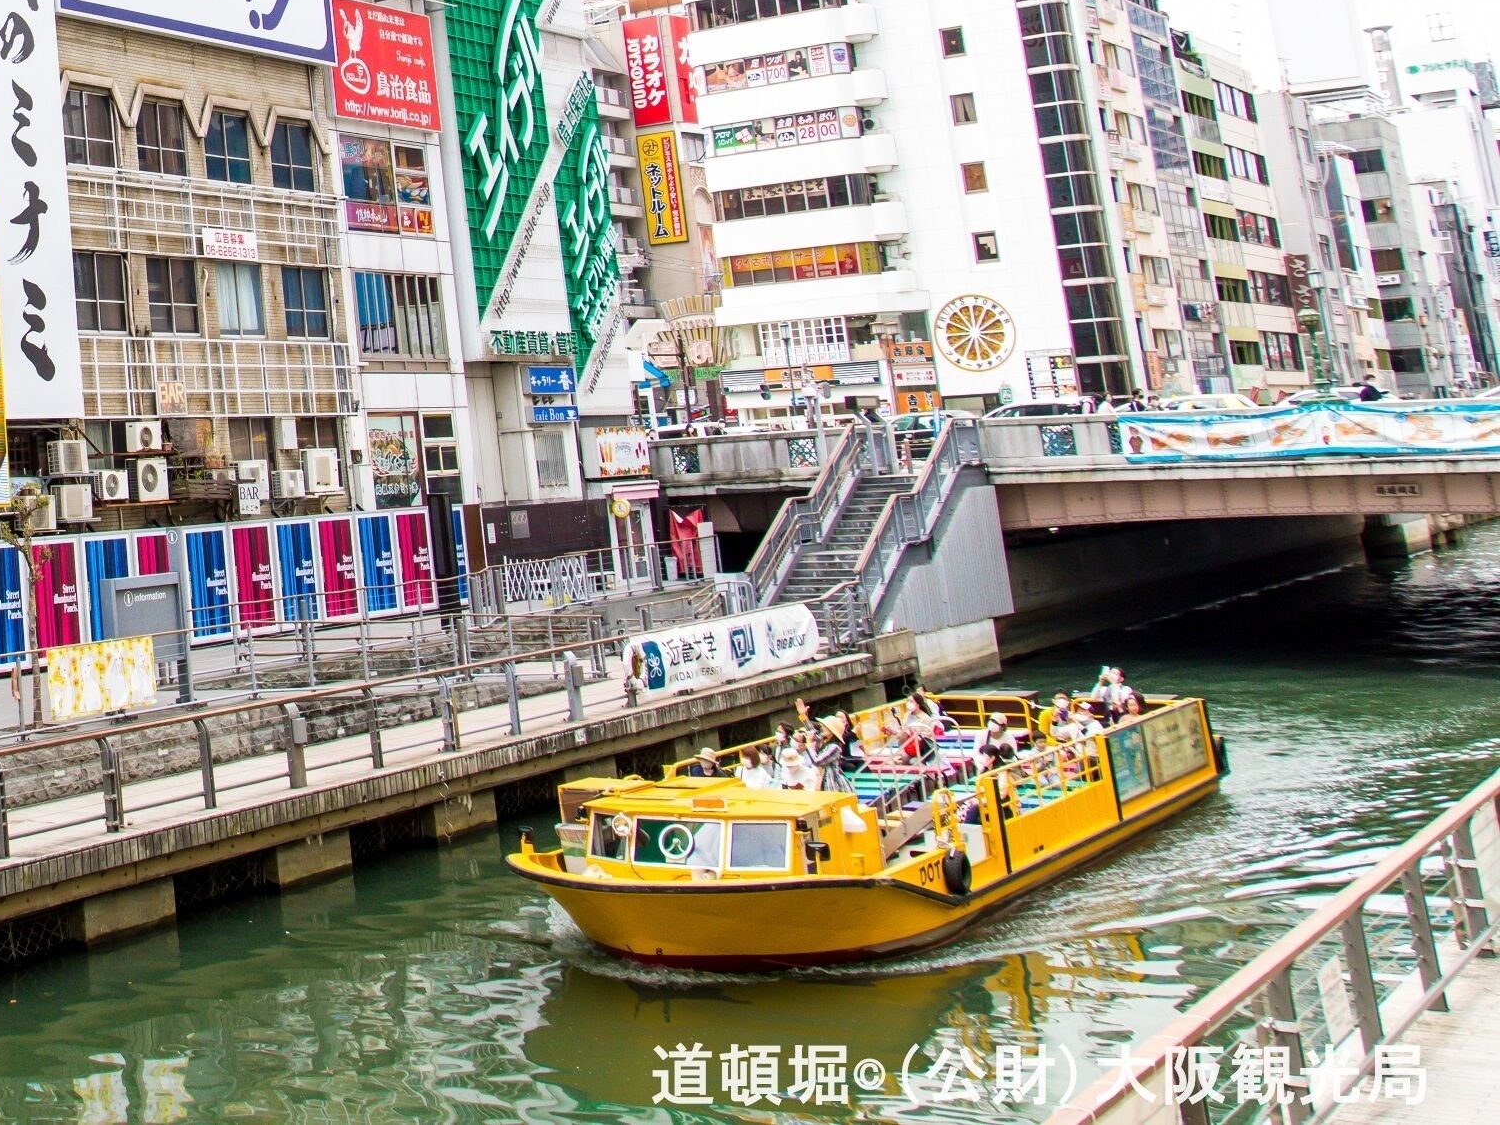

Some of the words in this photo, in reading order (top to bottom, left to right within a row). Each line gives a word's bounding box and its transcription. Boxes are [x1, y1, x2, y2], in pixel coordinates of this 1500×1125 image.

[627, 38, 647, 109] JOYSOUND
[642, 35, 666, 107] カラオケ
[377, 72, 432, 105] 鳥治食品
[561, 127, 611, 273] エイブル
[646, 163, 669, 238] ネットルーム
[494, 181, 551, 320] http://www.able.co.jp
[490, 330, 578, 355] 不動産賃貸・管理
[160, 382, 185, 403] BAR
[531, 375, 556, 387] ギャラリー
[549, 408, 565, 421] Bon
[240, 487, 259, 500] BAR
[5, 589, 20, 600] Street
[134, 590, 167, 602] information
[663, 630, 717, 666] 近畿大学
